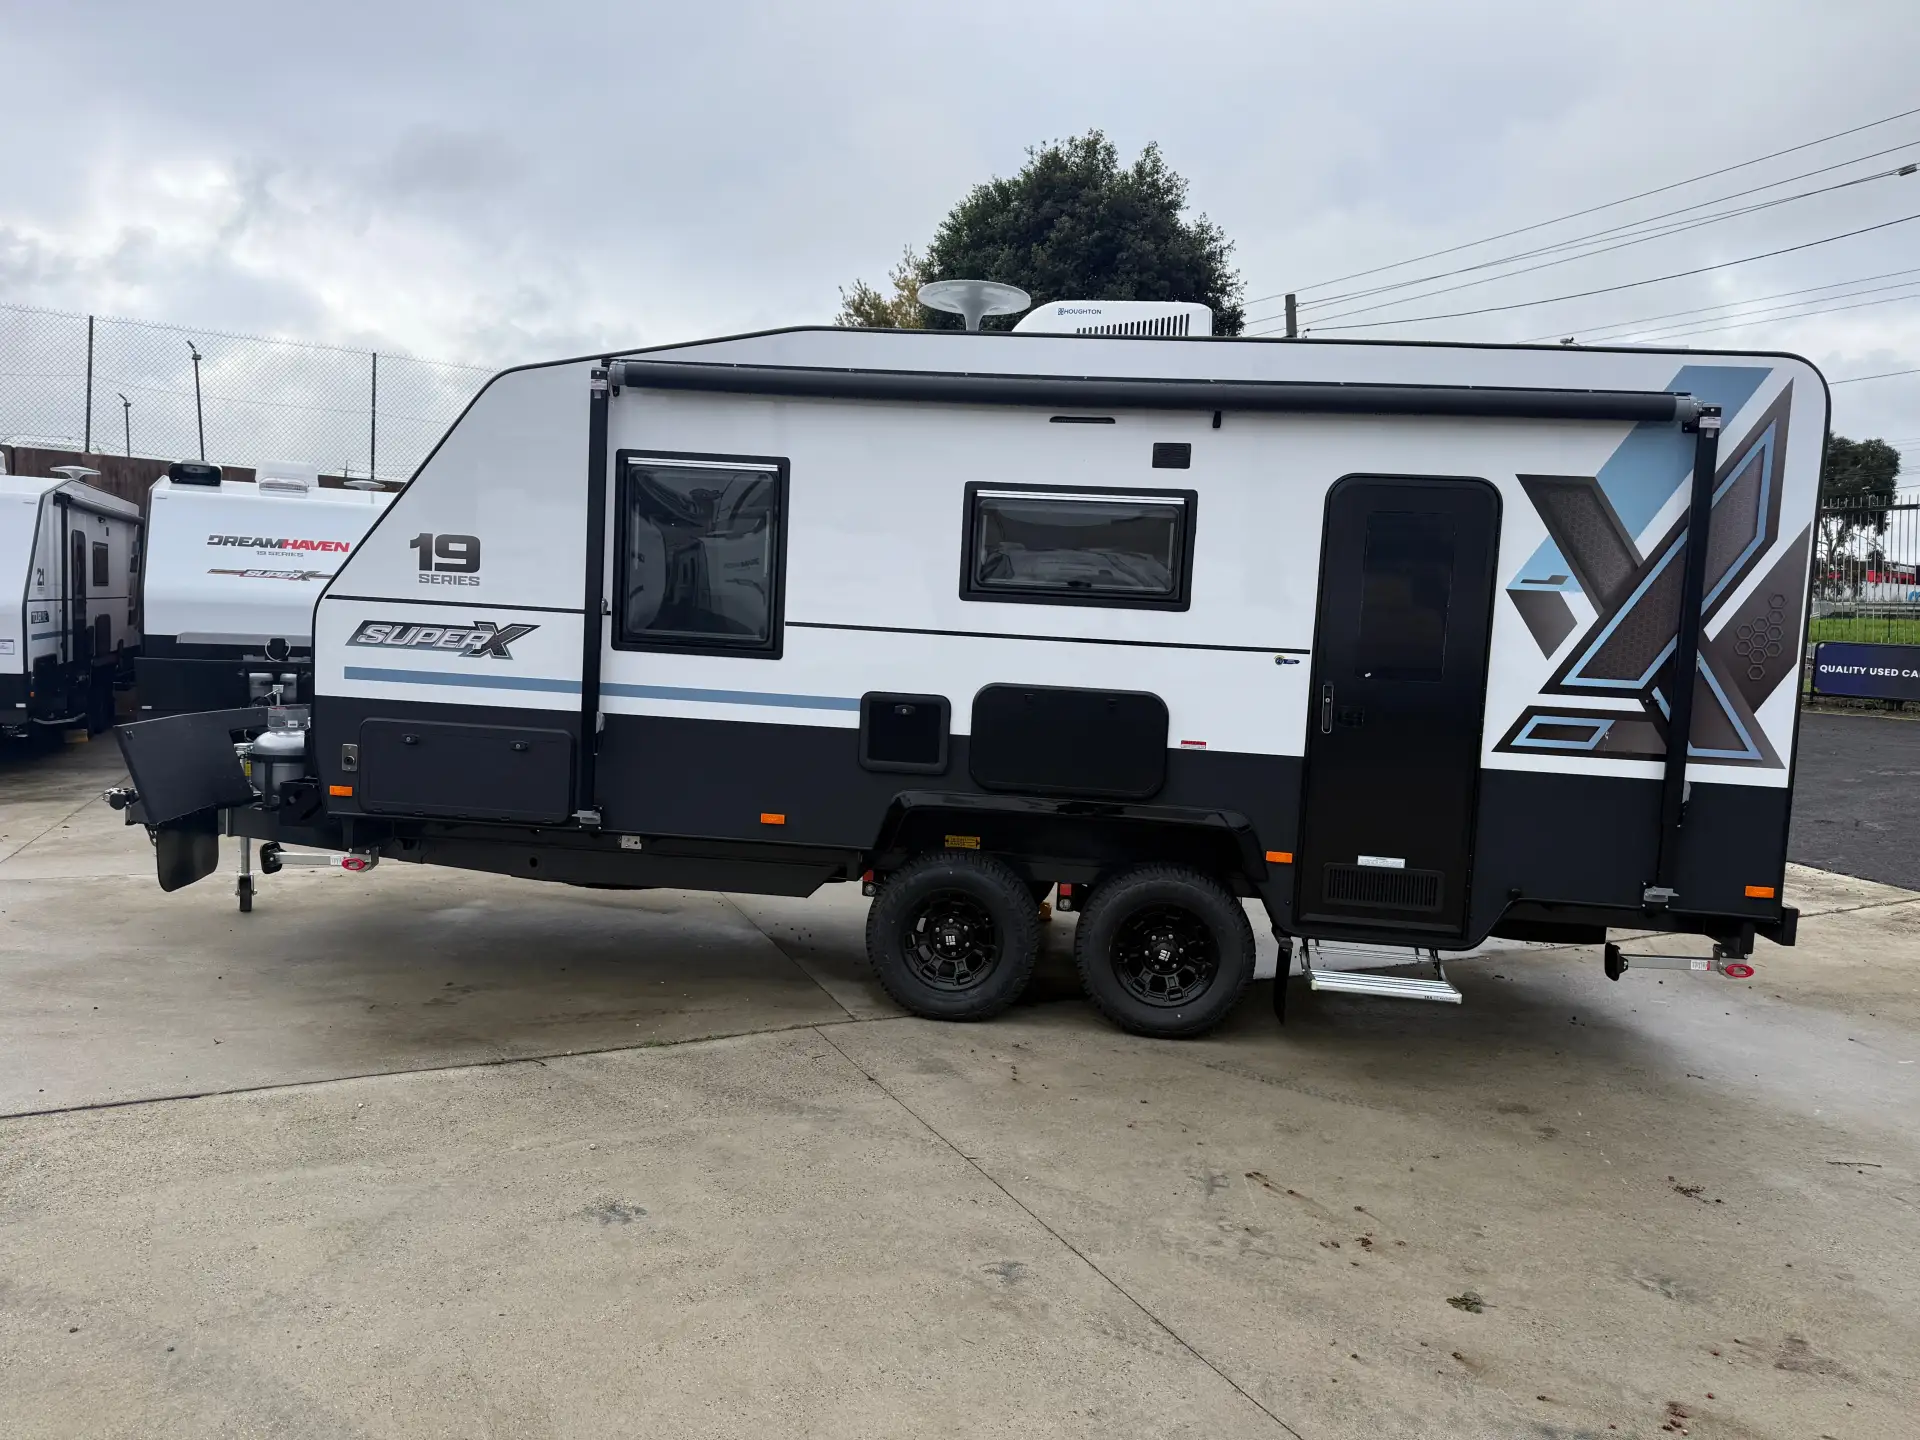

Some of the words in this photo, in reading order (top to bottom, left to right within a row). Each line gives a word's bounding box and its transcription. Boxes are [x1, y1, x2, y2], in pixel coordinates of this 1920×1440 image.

[207, 534, 350, 553] DREAMHAVEN
[410, 532, 481, 574] 19
[418, 573, 481, 587] SERIES
[1819, 664, 1867, 675] QUALITY
[1869, 667, 1899, 677] USED
[1901, 669, 1920, 678] CA
